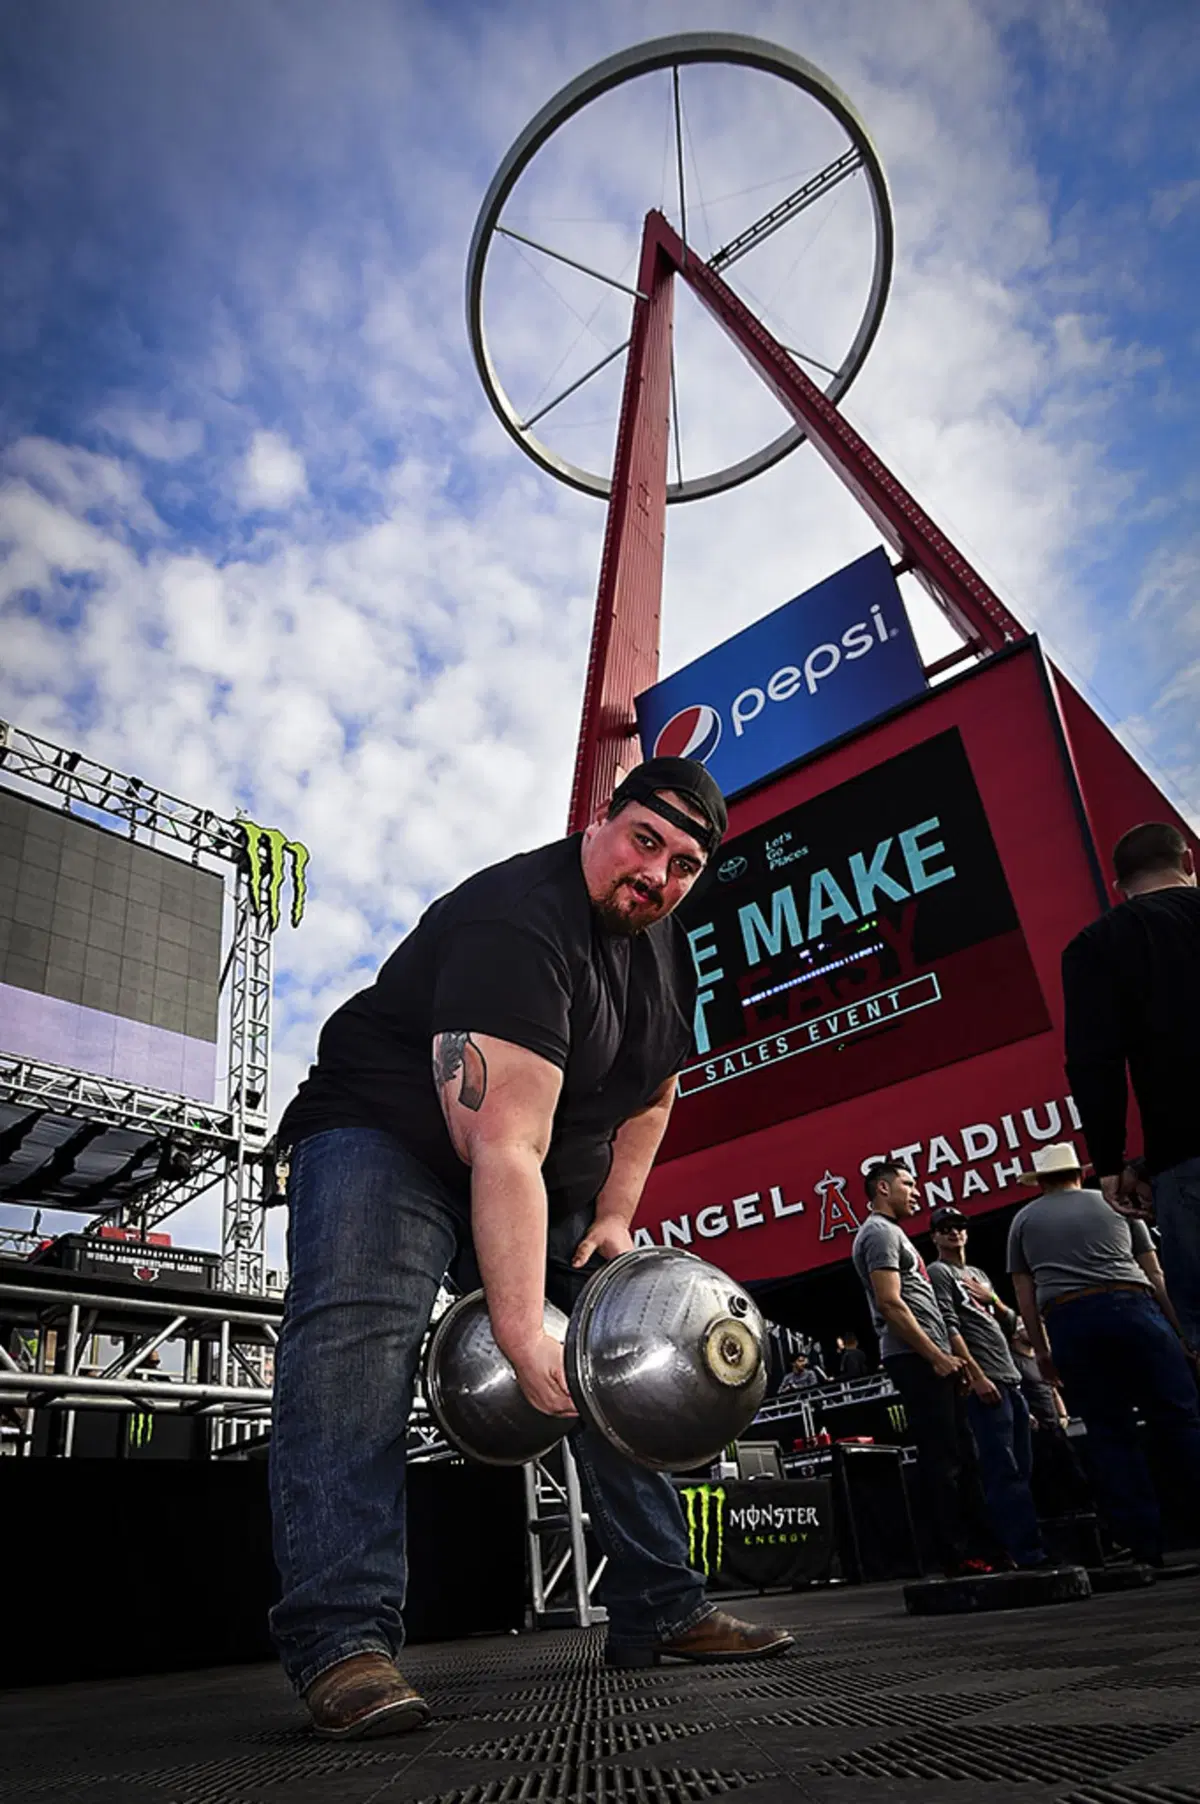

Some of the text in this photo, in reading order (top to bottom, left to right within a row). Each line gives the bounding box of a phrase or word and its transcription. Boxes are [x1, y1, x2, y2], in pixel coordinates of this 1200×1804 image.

[731, 604, 889, 737] pepsi
[765, 831, 792, 850] Let's
[766, 847, 784, 860] Go
[769, 845, 809, 871] Places
[737, 816, 956, 966] MAKE
[705, 992, 902, 1081] SALES EVENT
[633, 1186, 804, 1249] ANGEL
[860, 1095, 1083, 1178] TADIU
[729, 1503, 820, 1531] MONSTER
[744, 1532, 808, 1545] ENERGY
